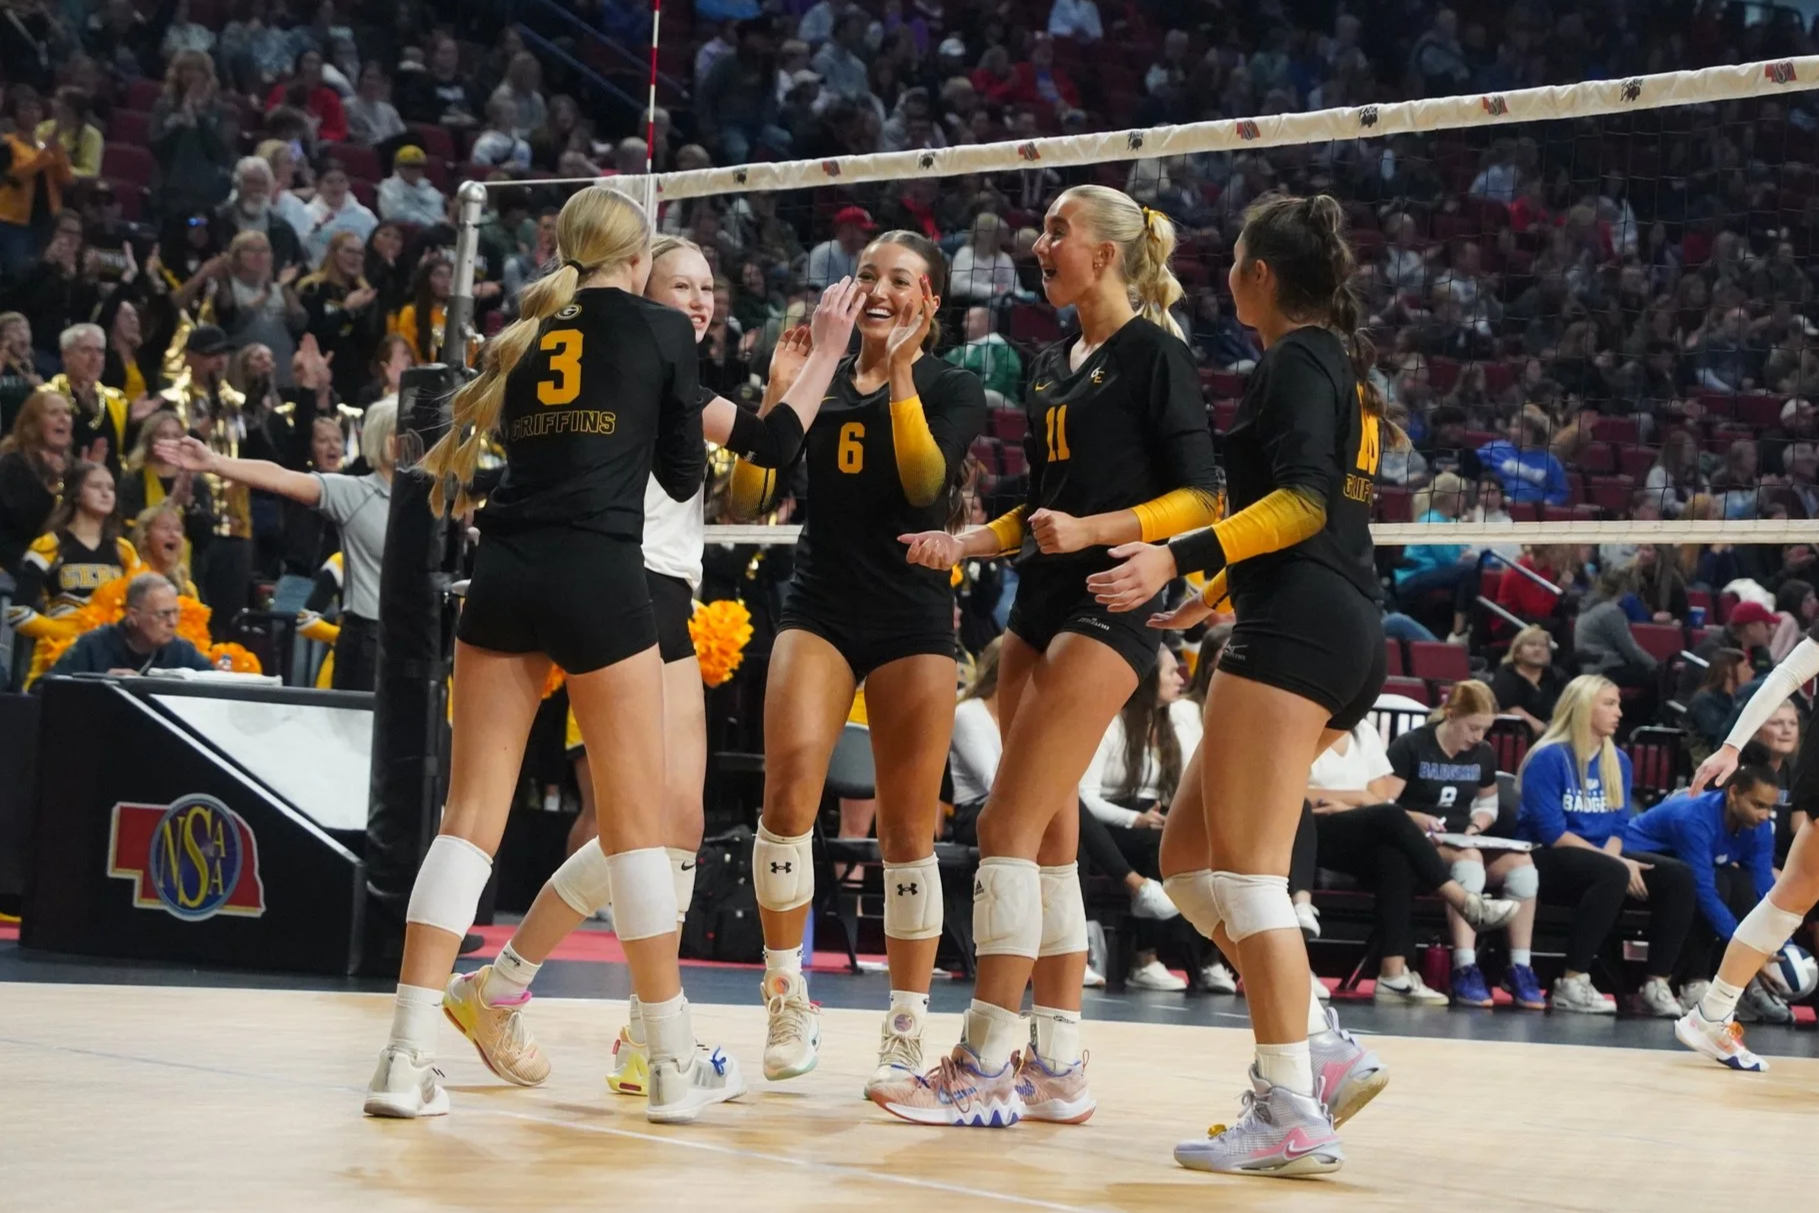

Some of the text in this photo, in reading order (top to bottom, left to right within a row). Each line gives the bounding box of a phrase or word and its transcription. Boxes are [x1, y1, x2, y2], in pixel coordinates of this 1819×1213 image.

[537, 328, 584, 406] 3
[511, 410, 616, 441] GRIFFINS
[838, 422, 865, 474] 6
[1046, 404, 1070, 462] 11
